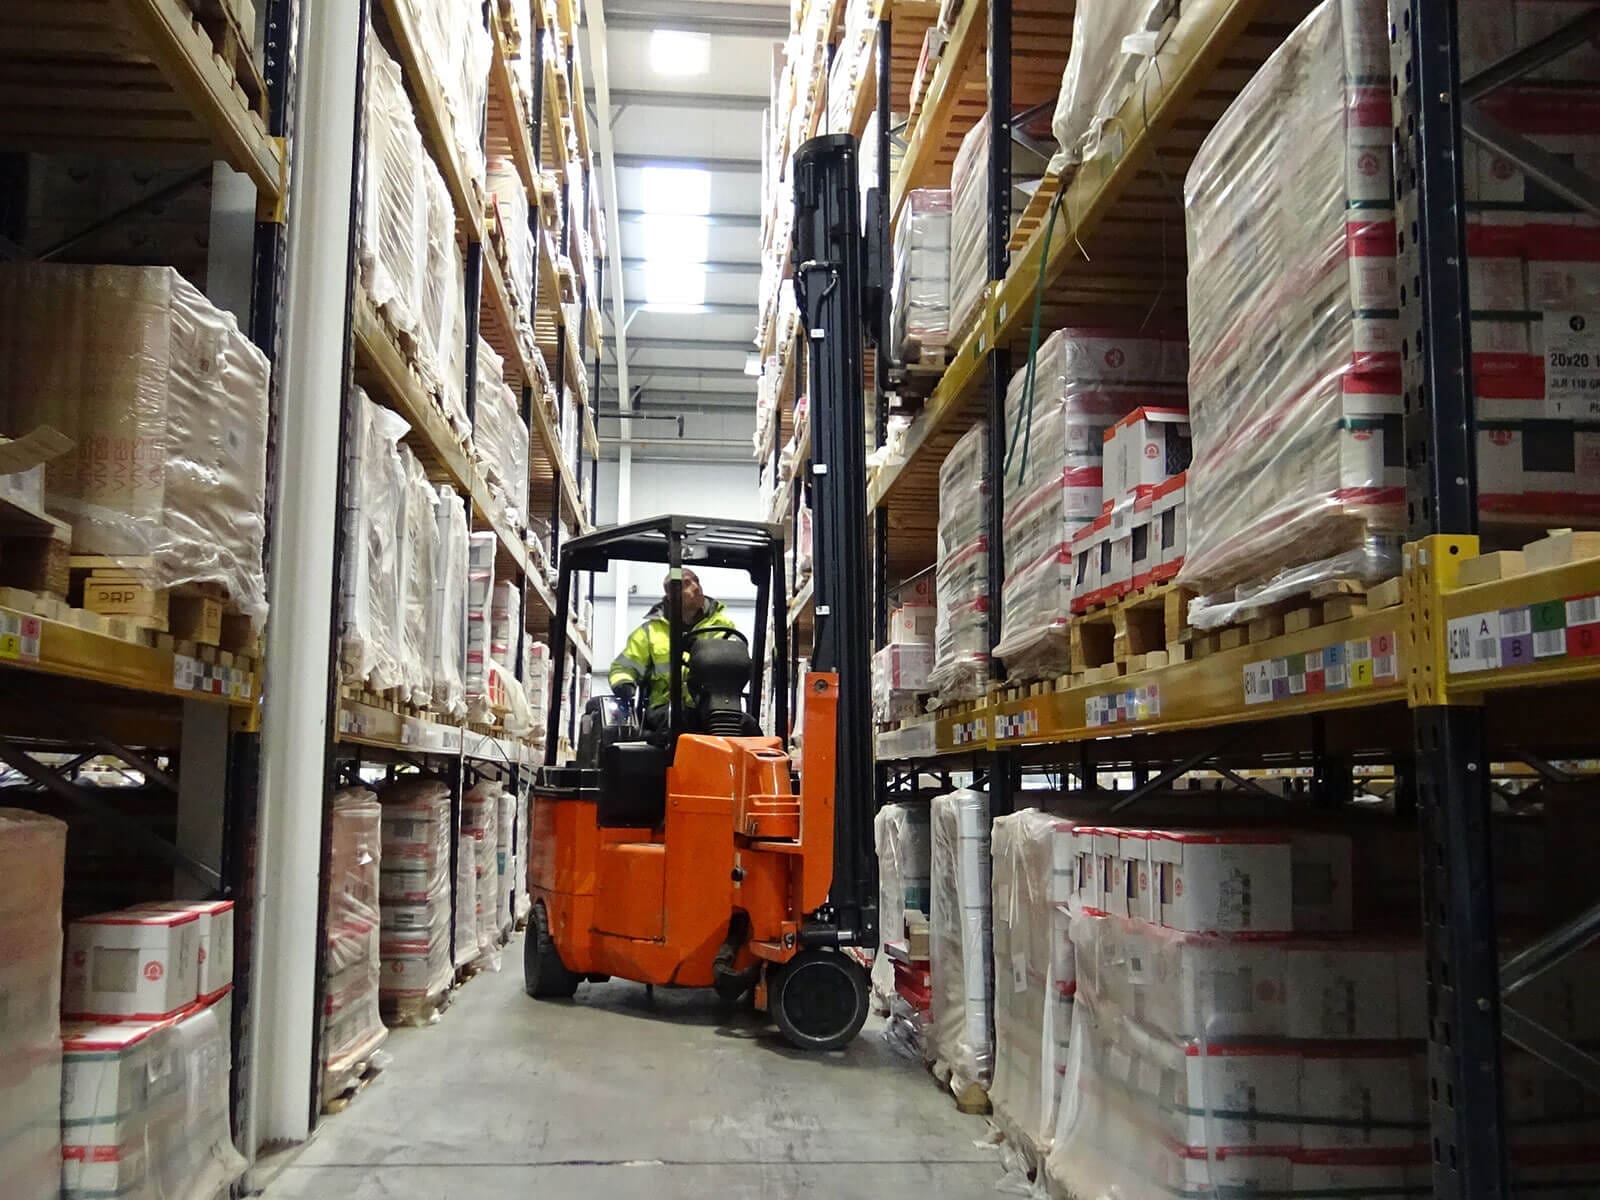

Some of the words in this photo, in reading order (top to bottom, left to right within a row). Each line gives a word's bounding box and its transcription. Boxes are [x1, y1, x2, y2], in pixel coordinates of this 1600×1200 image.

[1551, 353, 1589, 367] 20x20
[1480, 618, 1489, 635] A
[1379, 636, 1388, 652] G
[1511, 640, 1521, 657] B
[1260, 666, 1266, 677] A
[1358, 665, 1365, 680] F
